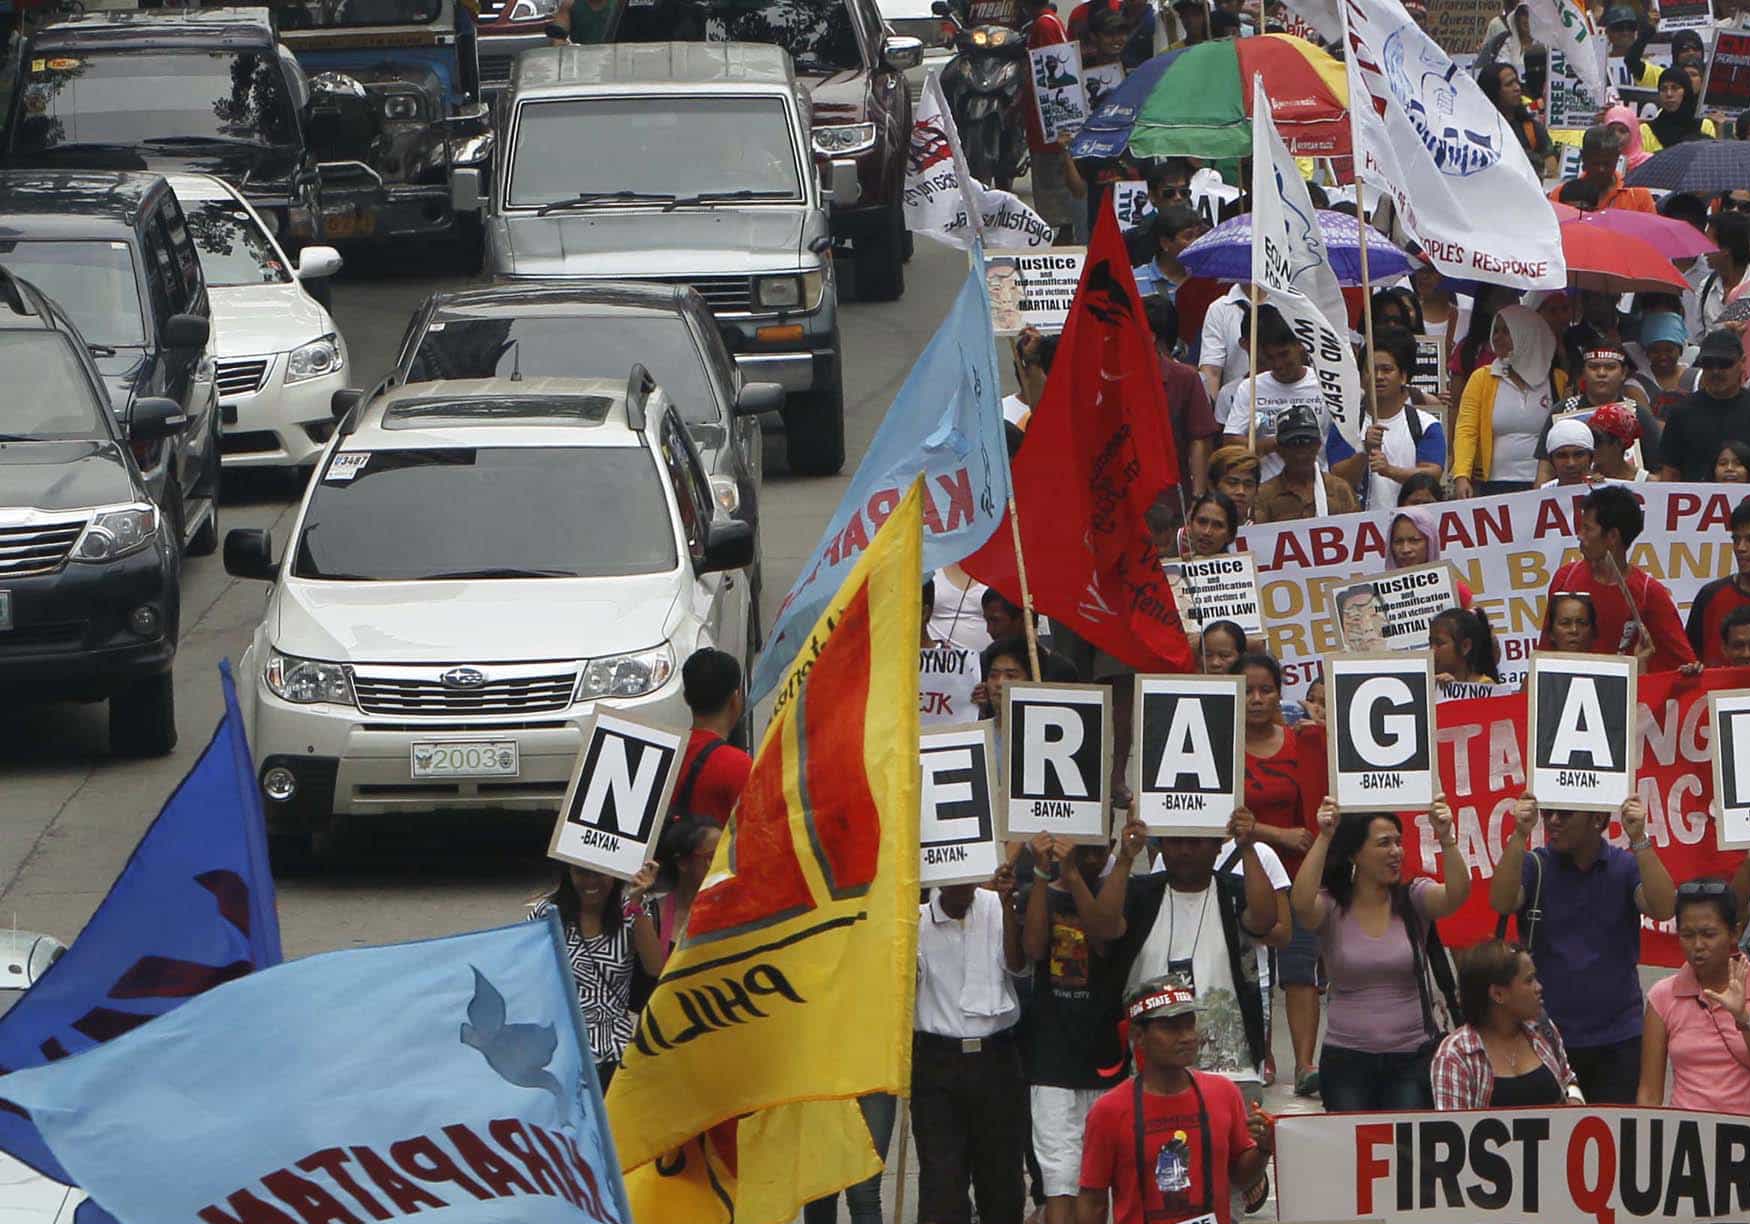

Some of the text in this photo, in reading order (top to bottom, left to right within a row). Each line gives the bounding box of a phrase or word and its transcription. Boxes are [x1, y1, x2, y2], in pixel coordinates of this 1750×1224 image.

[1473, 252, 1549, 279] RESPONSE
[1181, 560, 1244, 578] Justice
[1373, 571, 1440, 596] Justice
[1382, 618, 1428, 638] MARTIAL
[433, 748, 498, 769] 2003
[1023, 705, 1088, 797] R
[1155, 698, 1221, 790] A
[1349, 676, 1417, 768] G
[1549, 677, 1614, 768] A
[580, 734, 664, 836] N
[920, 749, 981, 846] E
[1145, 993, 1172, 1009] STATE
[1355, 1116, 1550, 1216] FIRST
